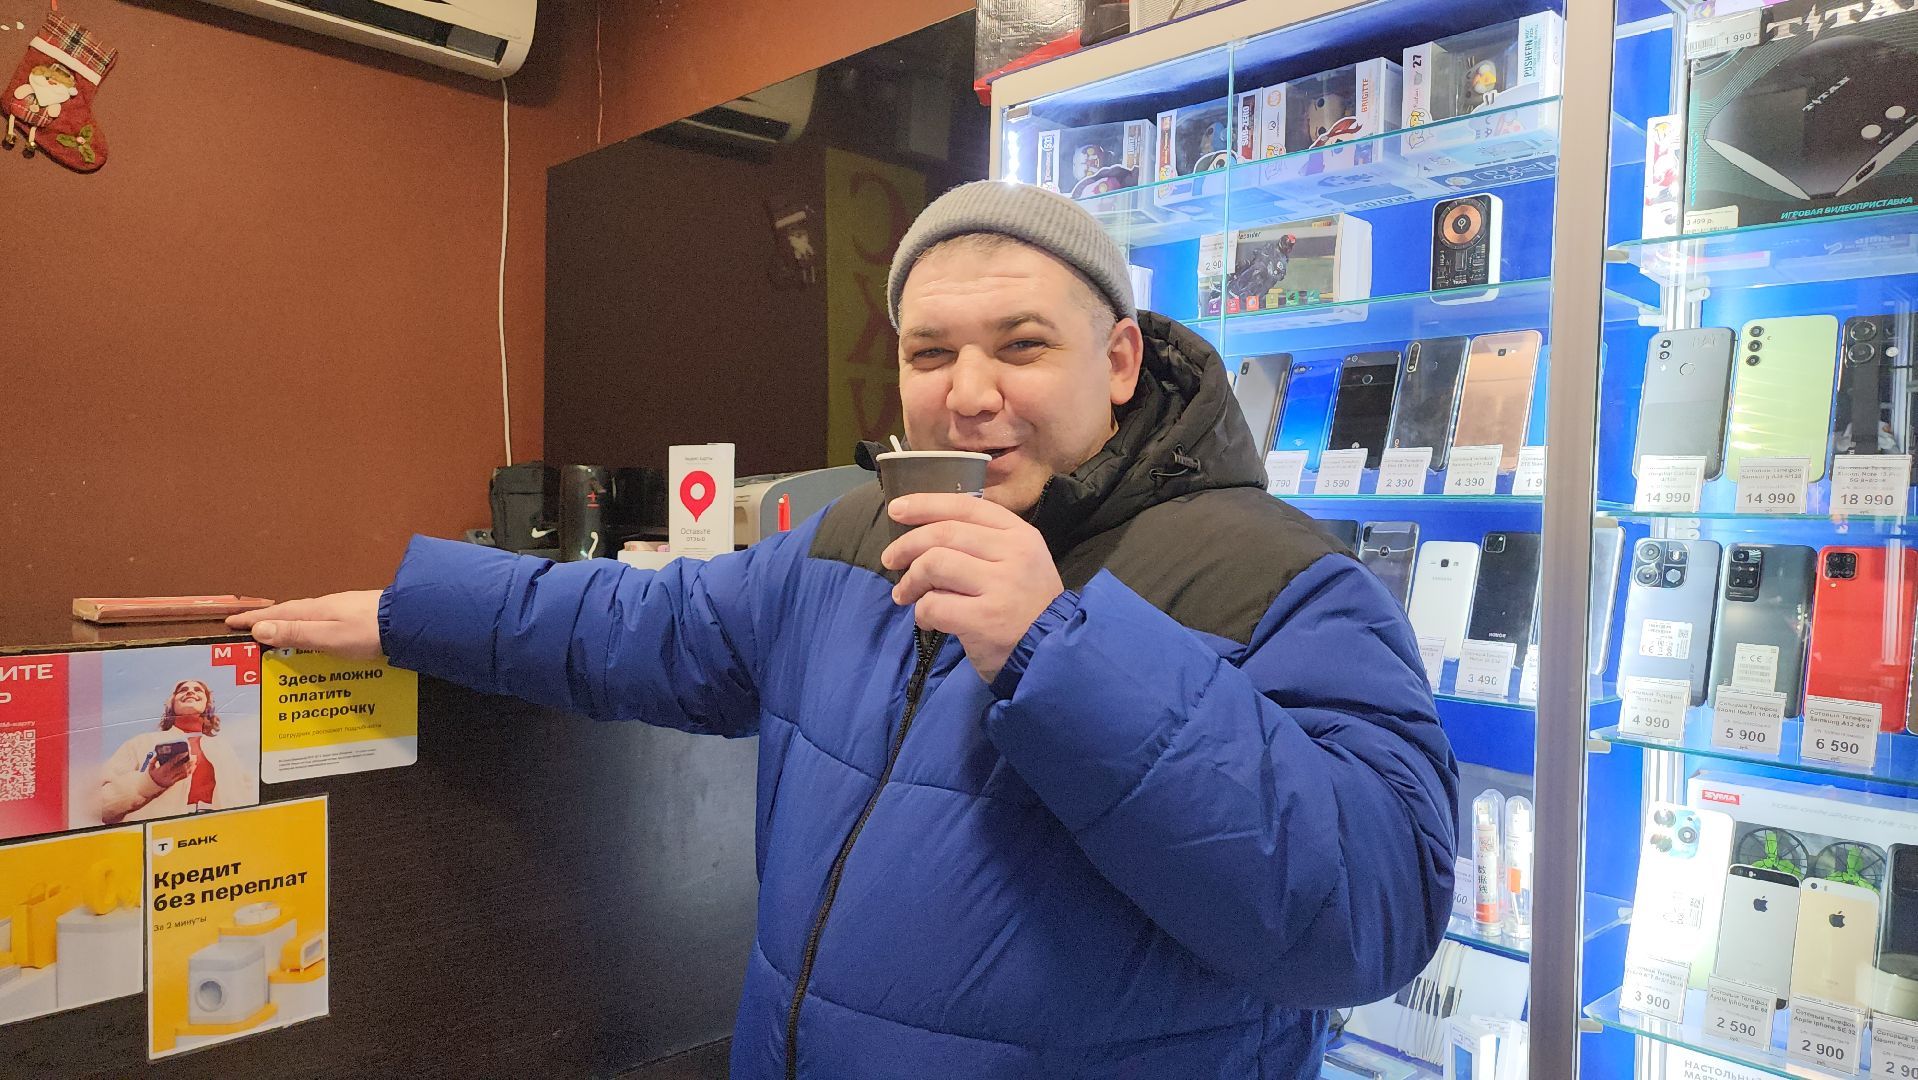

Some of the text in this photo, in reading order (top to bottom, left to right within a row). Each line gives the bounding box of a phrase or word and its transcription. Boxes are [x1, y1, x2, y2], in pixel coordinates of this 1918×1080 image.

[1766, 0, 1918, 41] TITA
[1733, 32, 1751, 43] 990
[1413, 55, 1422, 68] 27
[1361, 78, 1369, 113] BRIGITTE
[1781, 197, 1913, 220] ИГРОВАЯ ВИДЕОПРИСТАВКА
[1206, 260, 1222, 271] 2 90
[1276, 480, 1291, 488] 790
[1325, 480, 1350, 488] 3 590
[1386, 479, 1414, 488] 2 390
[1455, 478, 1485, 487] 4 390
[1527, 479, 1532, 488] 1
[1645, 492, 1691, 503] 14 990
[1745, 493, 1796, 504] 14 990
[1840, 494, 1894, 506] 18 990
[215, 645, 257, 659] М Т
[279, 668, 383, 688] Здесь можно
[1468, 674, 1497, 686] 3 490
[279, 689, 352, 704] оплатить
[279, 702, 376, 723] в рассрочку
[1633, 715, 1670, 729] 4 990
[1726, 728, 1766, 743] 5 900
[1816, 738, 1859, 755] 6 590
[178, 834, 218, 849] БАНК
[154, 862, 242, 890] Кредит
[154, 871, 308, 912] без переплат
[154, 924, 164, 932] За
[175, 916, 207, 929] минуты
[1635, 991, 1670, 1010] 3 900
[1717, 1017, 1756, 1037] 2 590
[1794, 1016, 1813, 1026] Apple
[1827, 1016, 1856, 1029] Телефон
[1802, 1039, 1845, 1061] 2 900
[1886, 1062, 1918, 1079] 2 90
